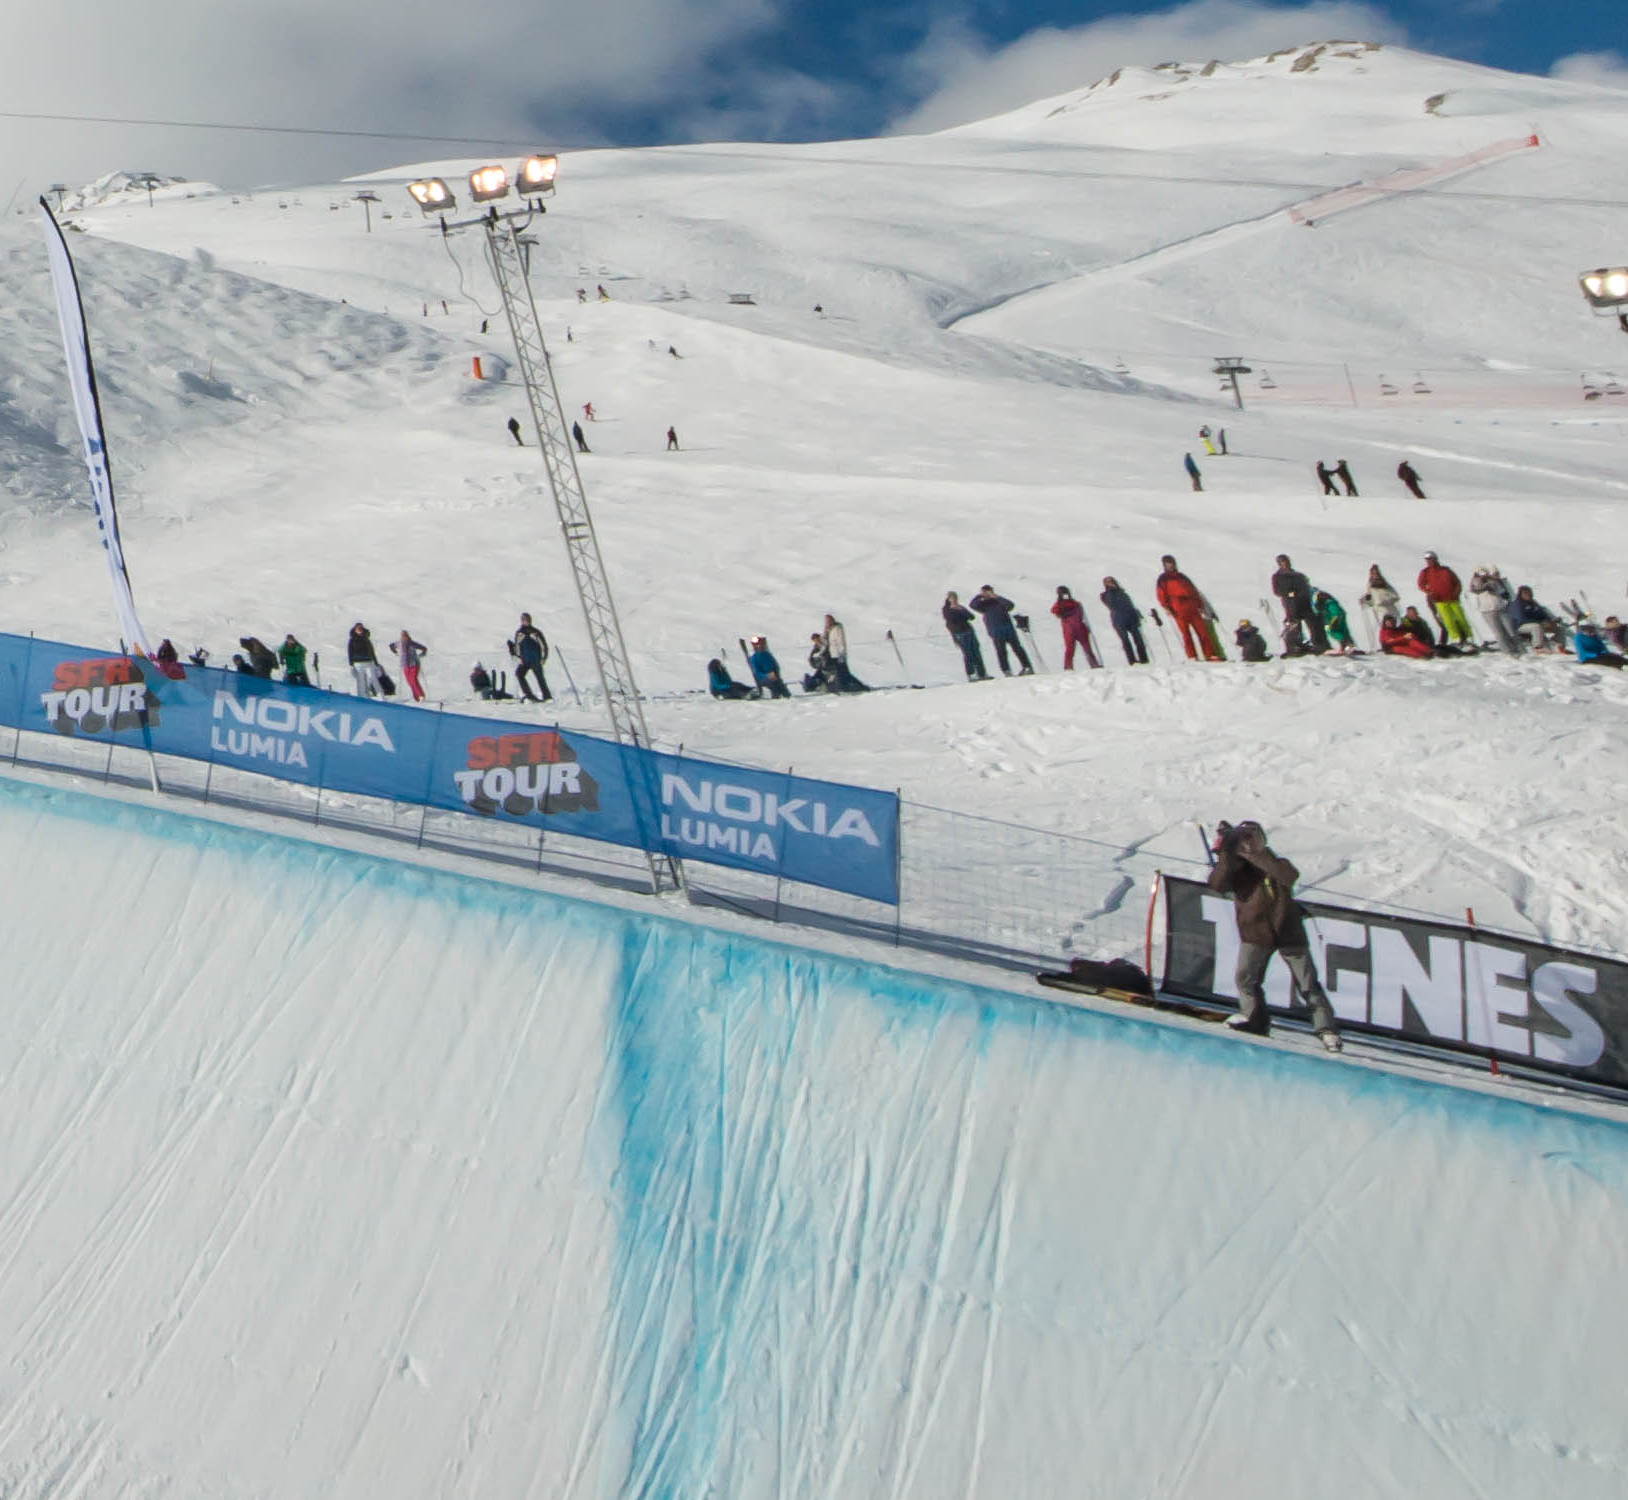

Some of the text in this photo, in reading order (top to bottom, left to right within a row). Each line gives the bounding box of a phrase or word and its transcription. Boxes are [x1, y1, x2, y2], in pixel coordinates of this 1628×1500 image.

[52, 658, 133, 691] SFR
[41, 683, 148, 728] TOUR
[213, 690, 396, 753] NOKIA
[211, 726, 309, 768] LUMIA
[467, 731, 560, 769] SFR
[454, 762, 582, 809] TOUR
[661, 773, 881, 847] NOKIA
[661, 812, 777, 862] LUMIA
